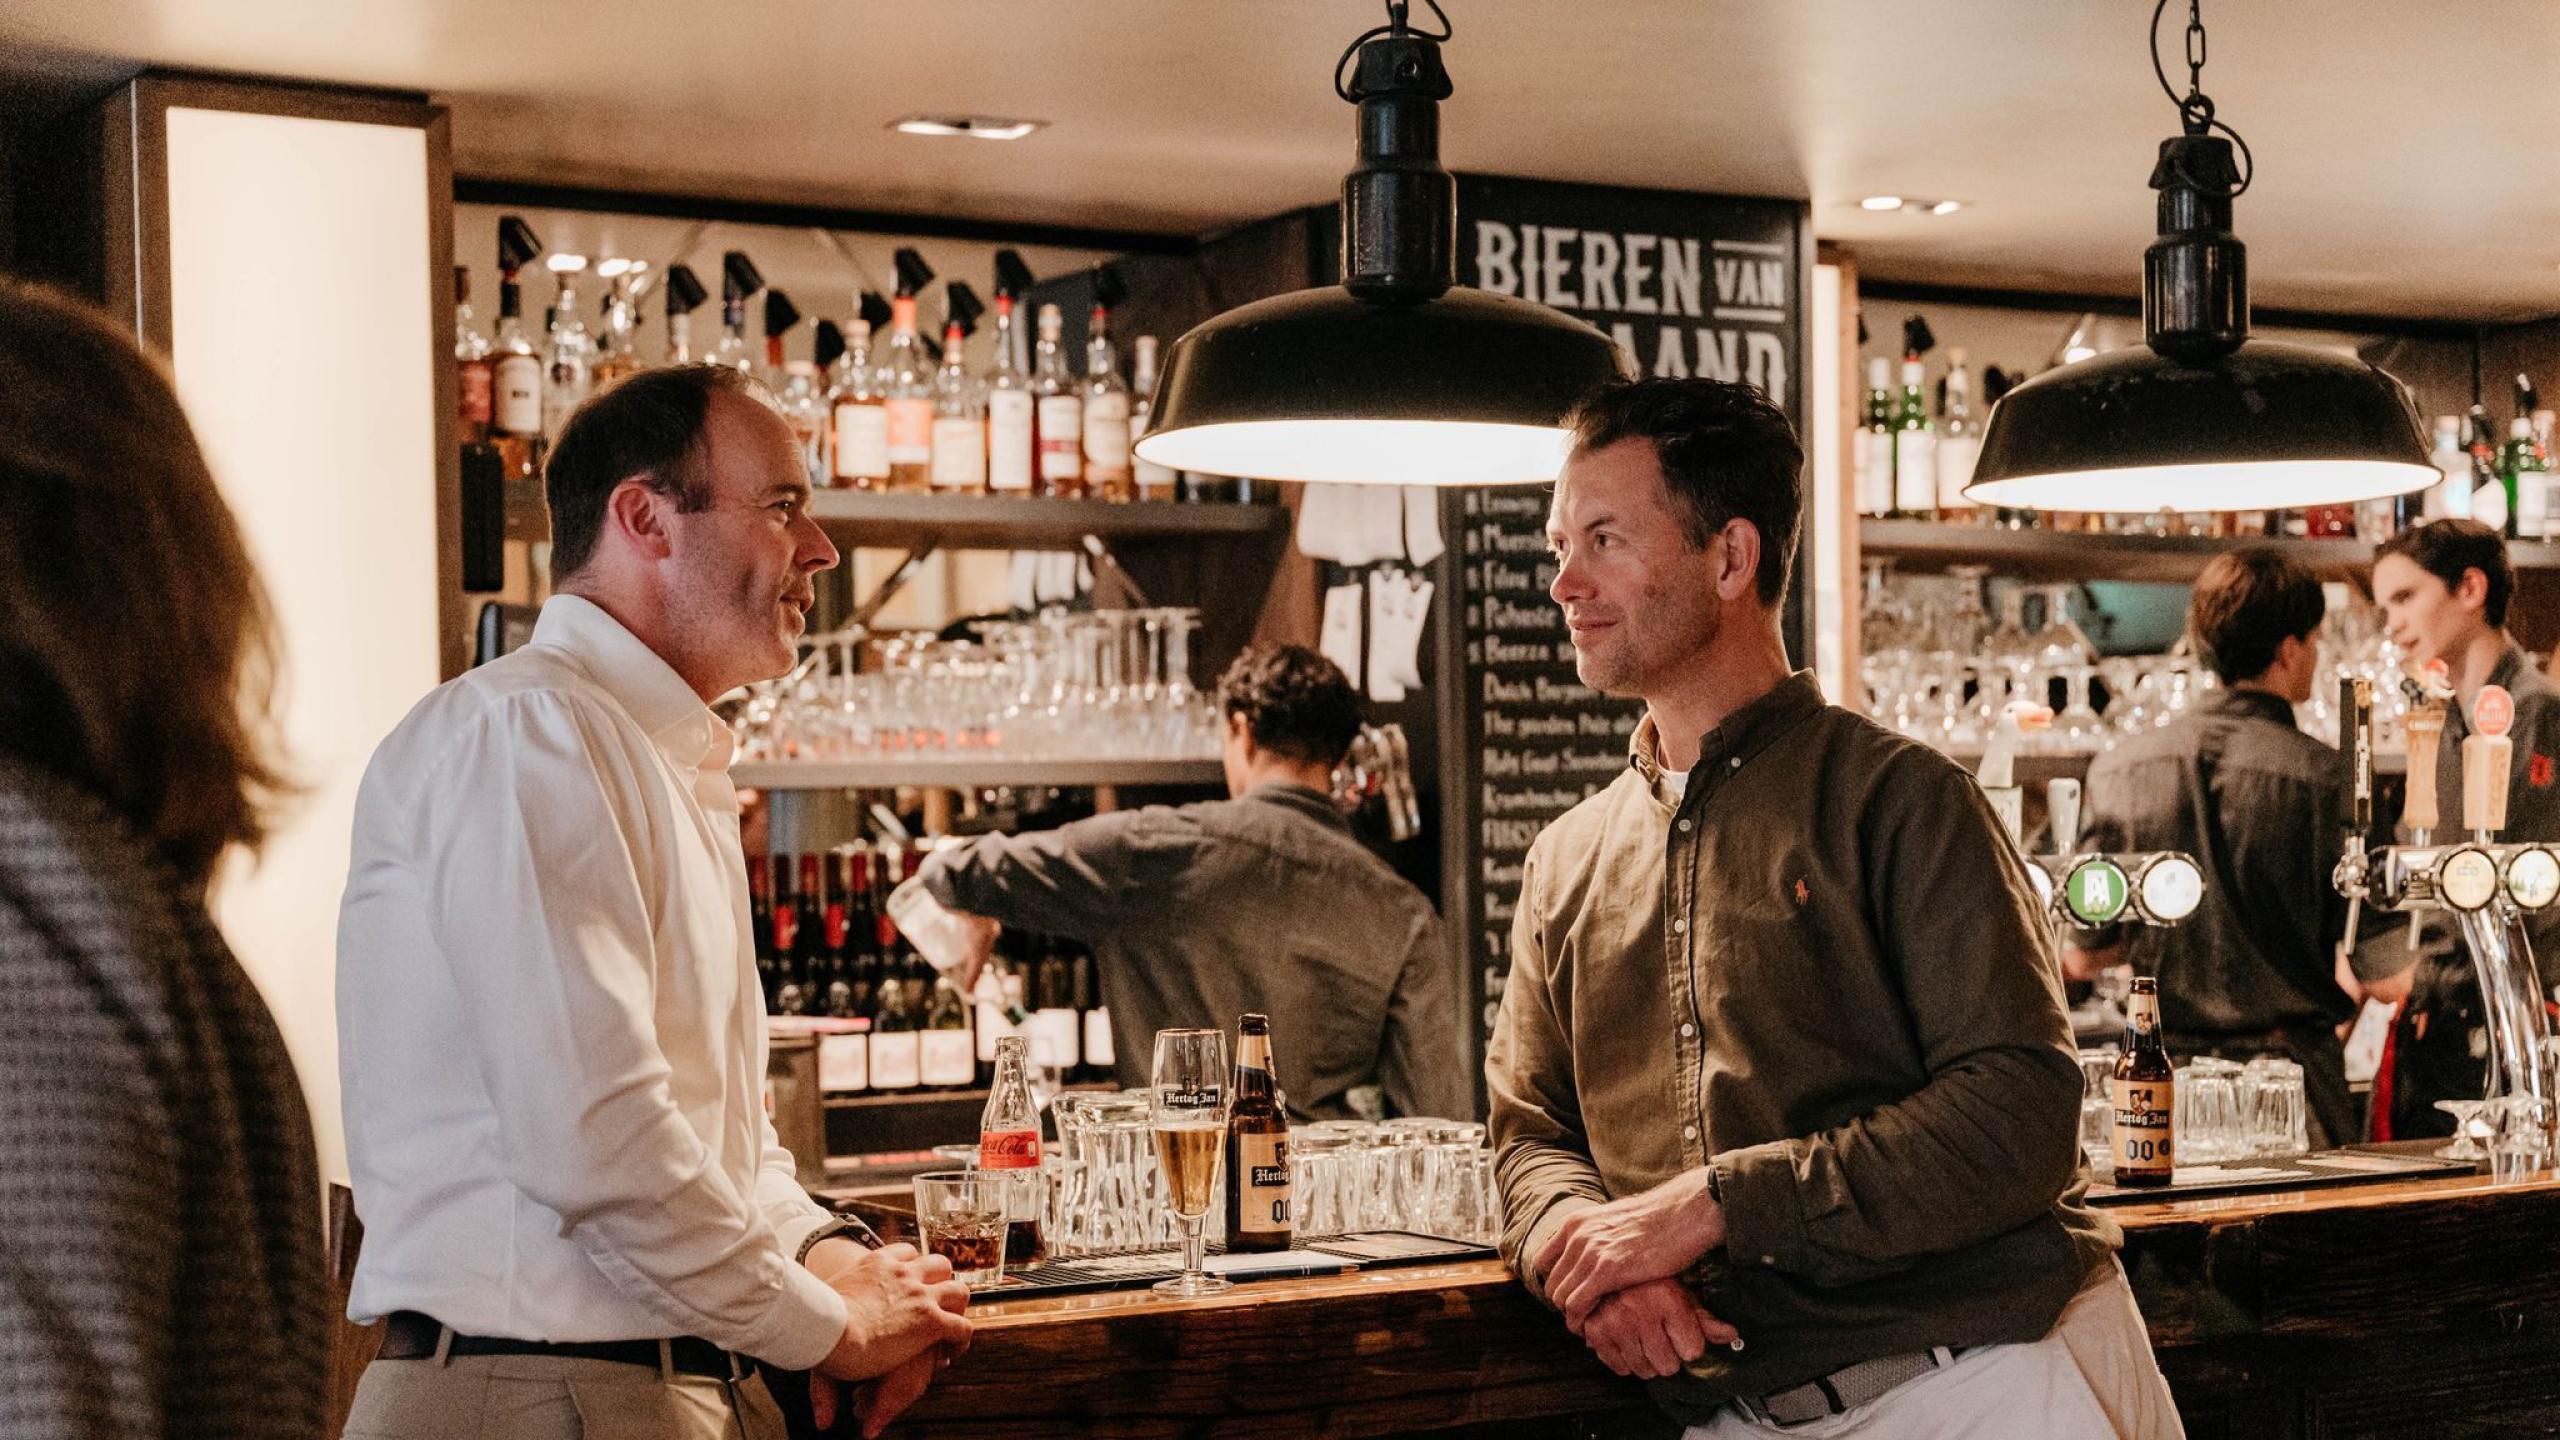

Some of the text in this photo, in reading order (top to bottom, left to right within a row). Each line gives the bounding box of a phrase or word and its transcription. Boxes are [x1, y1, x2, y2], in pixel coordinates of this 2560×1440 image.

[1475, 219, 1786, 318] BIEREN VAN
[1165, 1092, 1217, 1105] Hertog Jan
[2115, 1110, 2148, 1126] Hertog
